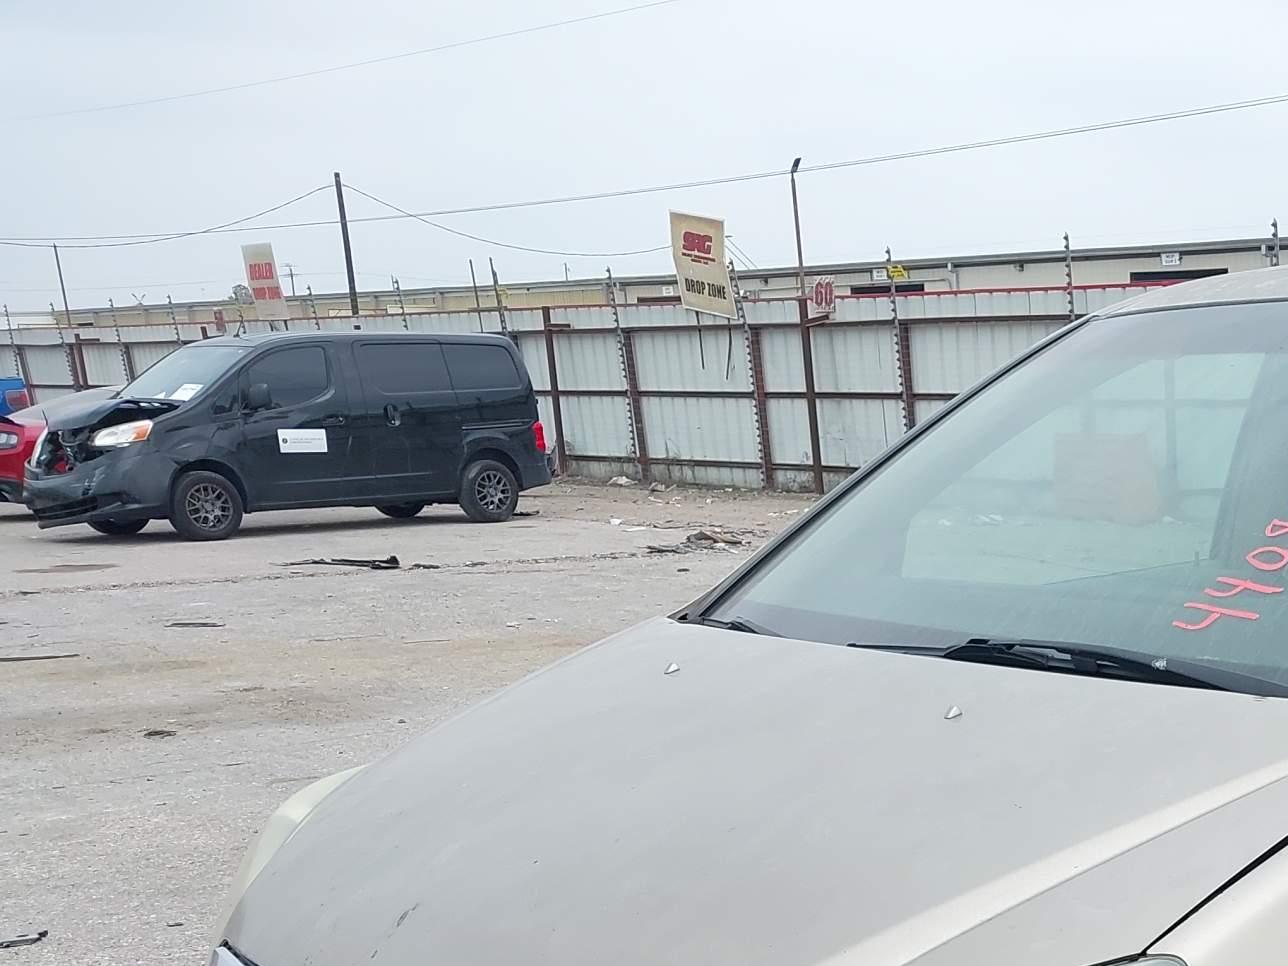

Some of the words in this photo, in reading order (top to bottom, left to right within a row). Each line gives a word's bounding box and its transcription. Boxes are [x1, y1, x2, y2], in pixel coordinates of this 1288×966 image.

[685, 278, 706, 295] DROP
[707, 282, 728, 300] ZONE
[814, 281, 834, 306] 60
